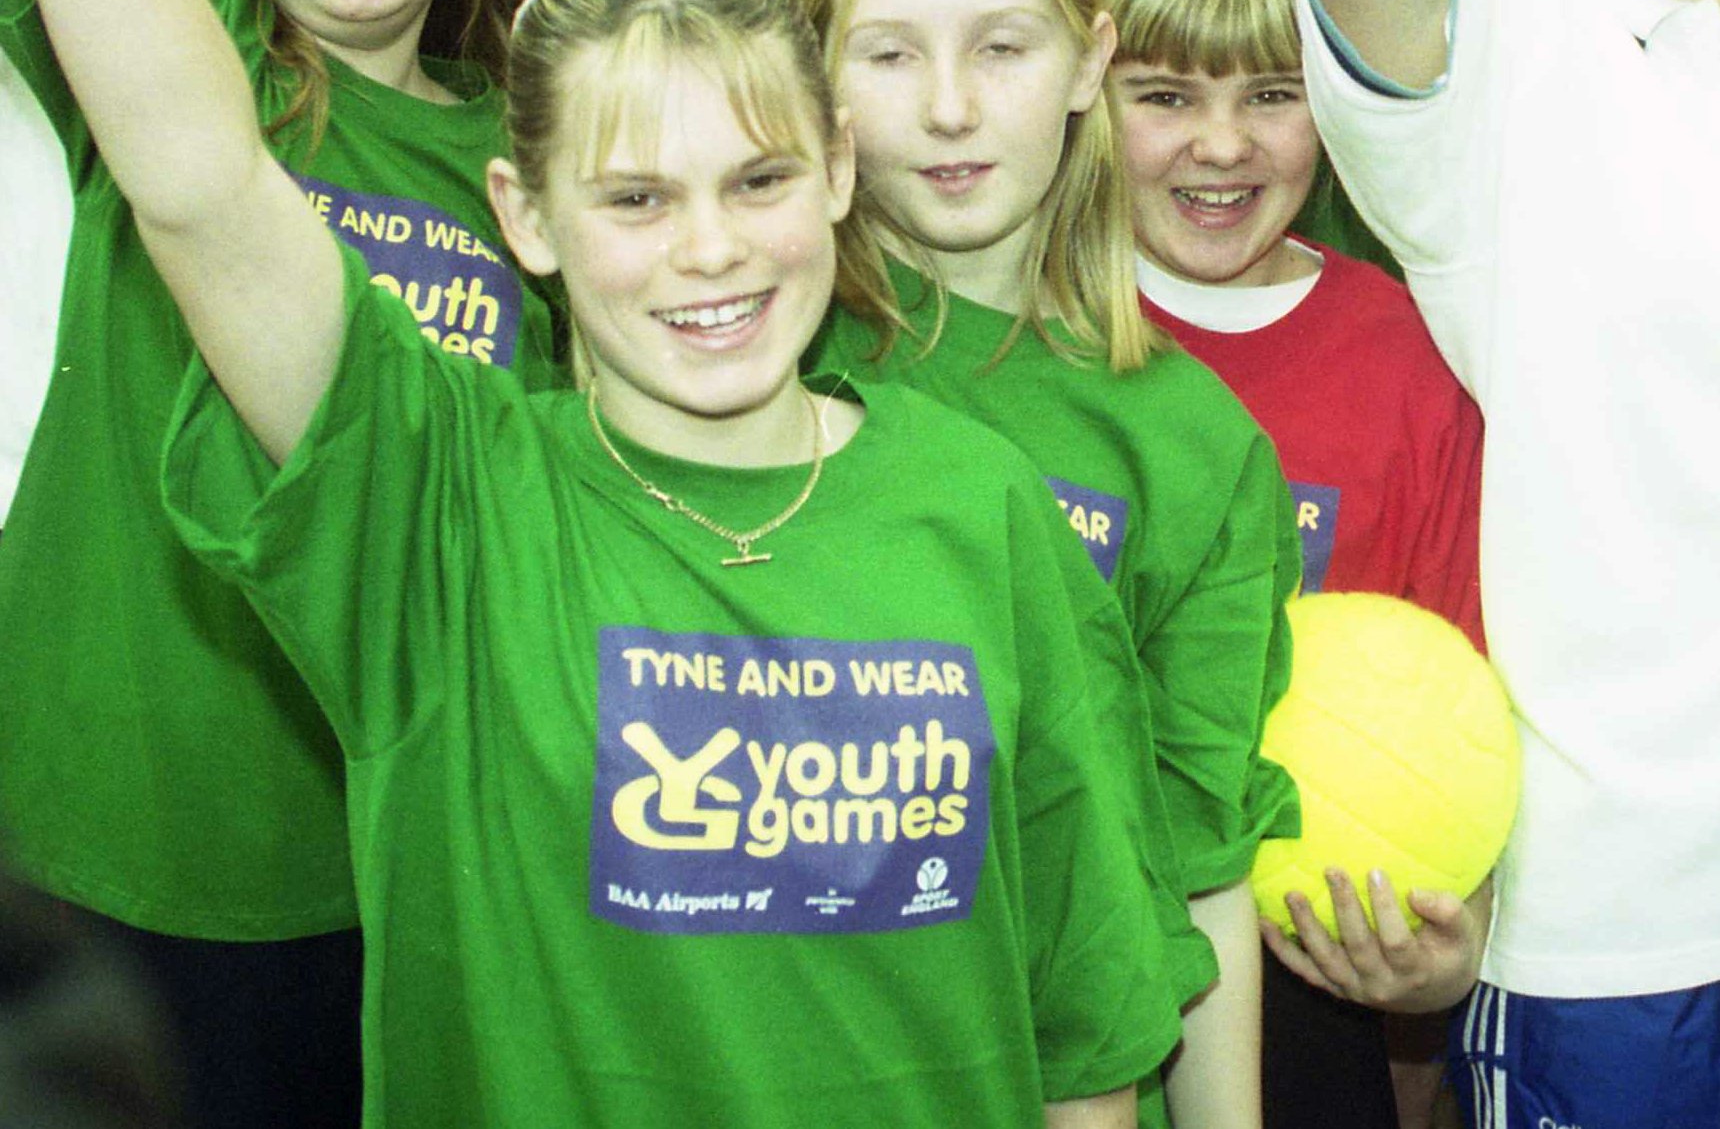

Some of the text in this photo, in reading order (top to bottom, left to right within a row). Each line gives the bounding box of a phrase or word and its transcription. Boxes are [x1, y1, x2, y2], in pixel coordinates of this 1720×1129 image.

[340, 206, 412, 244] AND
[1056, 499, 1111, 546] AR
[622, 647, 970, 697] TYNE AND WEAR
[745, 719, 972, 811] youth
[744, 794, 969, 858] games
[608, 883, 740, 915] BAA Airports
